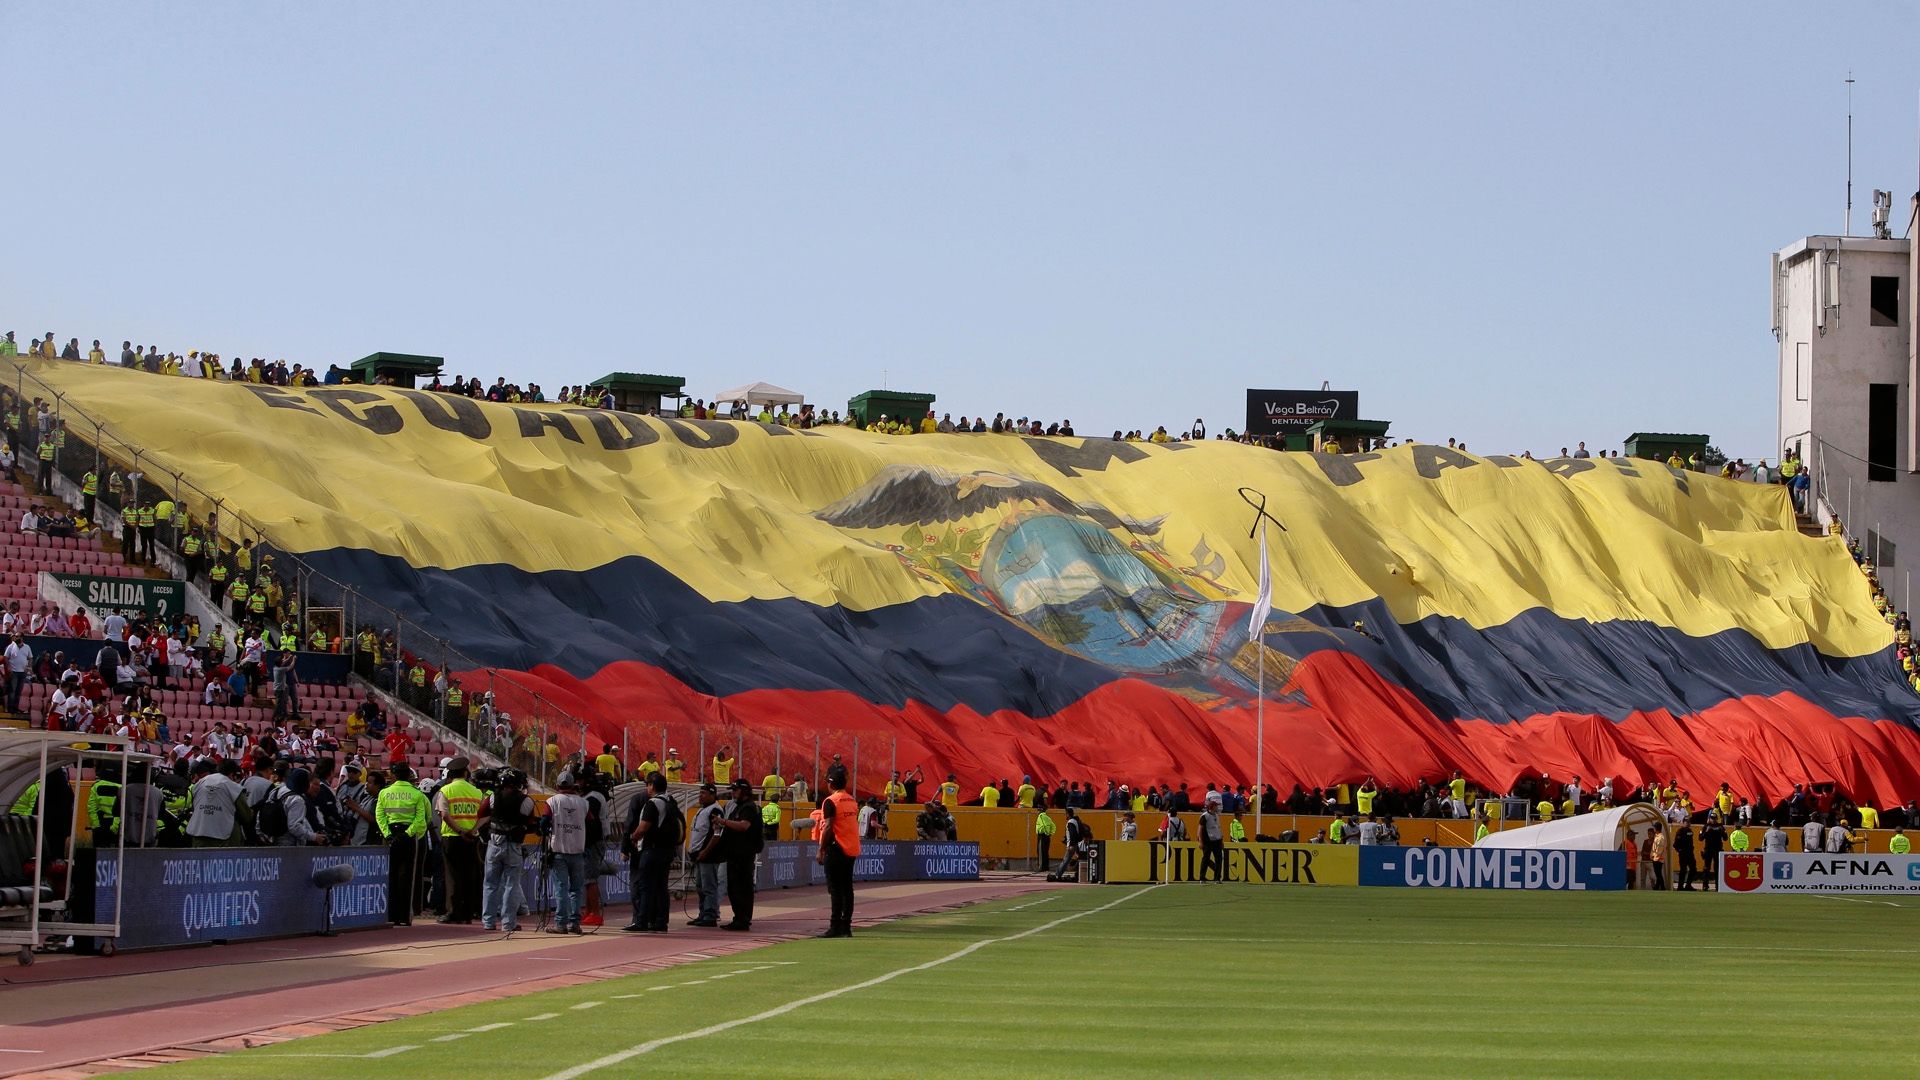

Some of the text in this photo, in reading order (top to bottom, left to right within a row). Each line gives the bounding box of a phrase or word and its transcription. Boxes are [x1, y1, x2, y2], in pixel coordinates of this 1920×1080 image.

[1264, 402, 1332, 415] Vega Beltrán
[88, 581, 145, 606] SALIDA
[153, 586, 173, 594] ACCESO
[386, 792, 412, 800] POLICIA
[926, 844, 938, 856] FIFA
[938, 844, 960, 856] WORLD
[960, 844, 971, 856] CUP
[163, 860, 183, 885] 2018
[184, 859, 202, 884] FIFA
[203, 858, 234, 884] WORLD
[235, 857, 251, 882] CUP
[369, 855, 381, 876] CUP
[926, 858, 978, 877] QUALIFIERS
[1405, 848, 1586, 890] CONMEBOL
[1806, 860, 1894, 876] AFNA
[183, 889, 260, 938] QUALIFIERS
